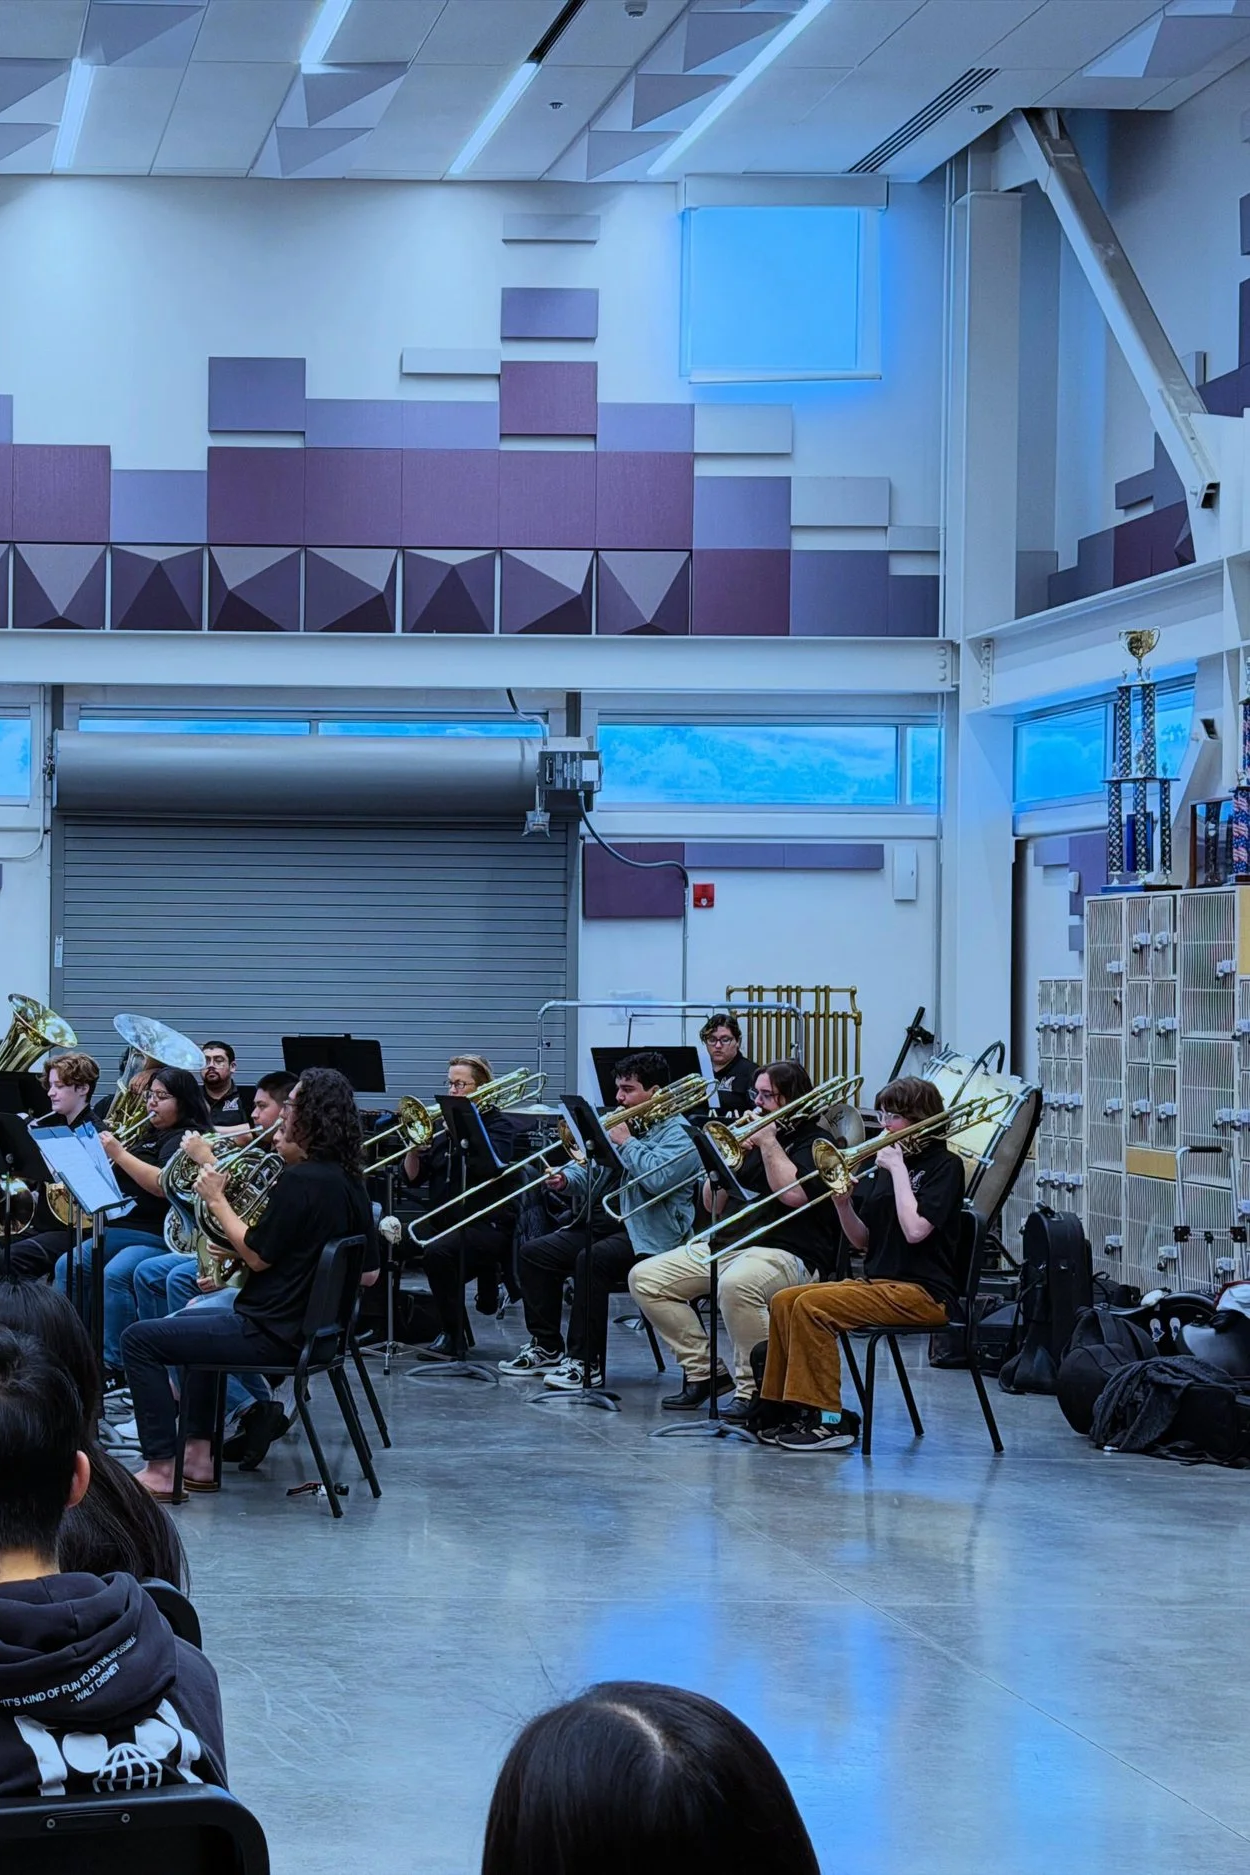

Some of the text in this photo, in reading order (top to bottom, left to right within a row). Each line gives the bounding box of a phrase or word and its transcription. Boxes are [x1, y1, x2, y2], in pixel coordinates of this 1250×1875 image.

[22, 1691, 46, 1705] KIND
[47, 1686, 60, 1698] OF
[61, 1680, 81, 1694] FUN
[80, 1673, 90, 1685] TO
[88, 1664, 101, 1677] DO
[74, 1682, 96, 1702] WALT
[94, 1661, 120, 1688] DISNEY
